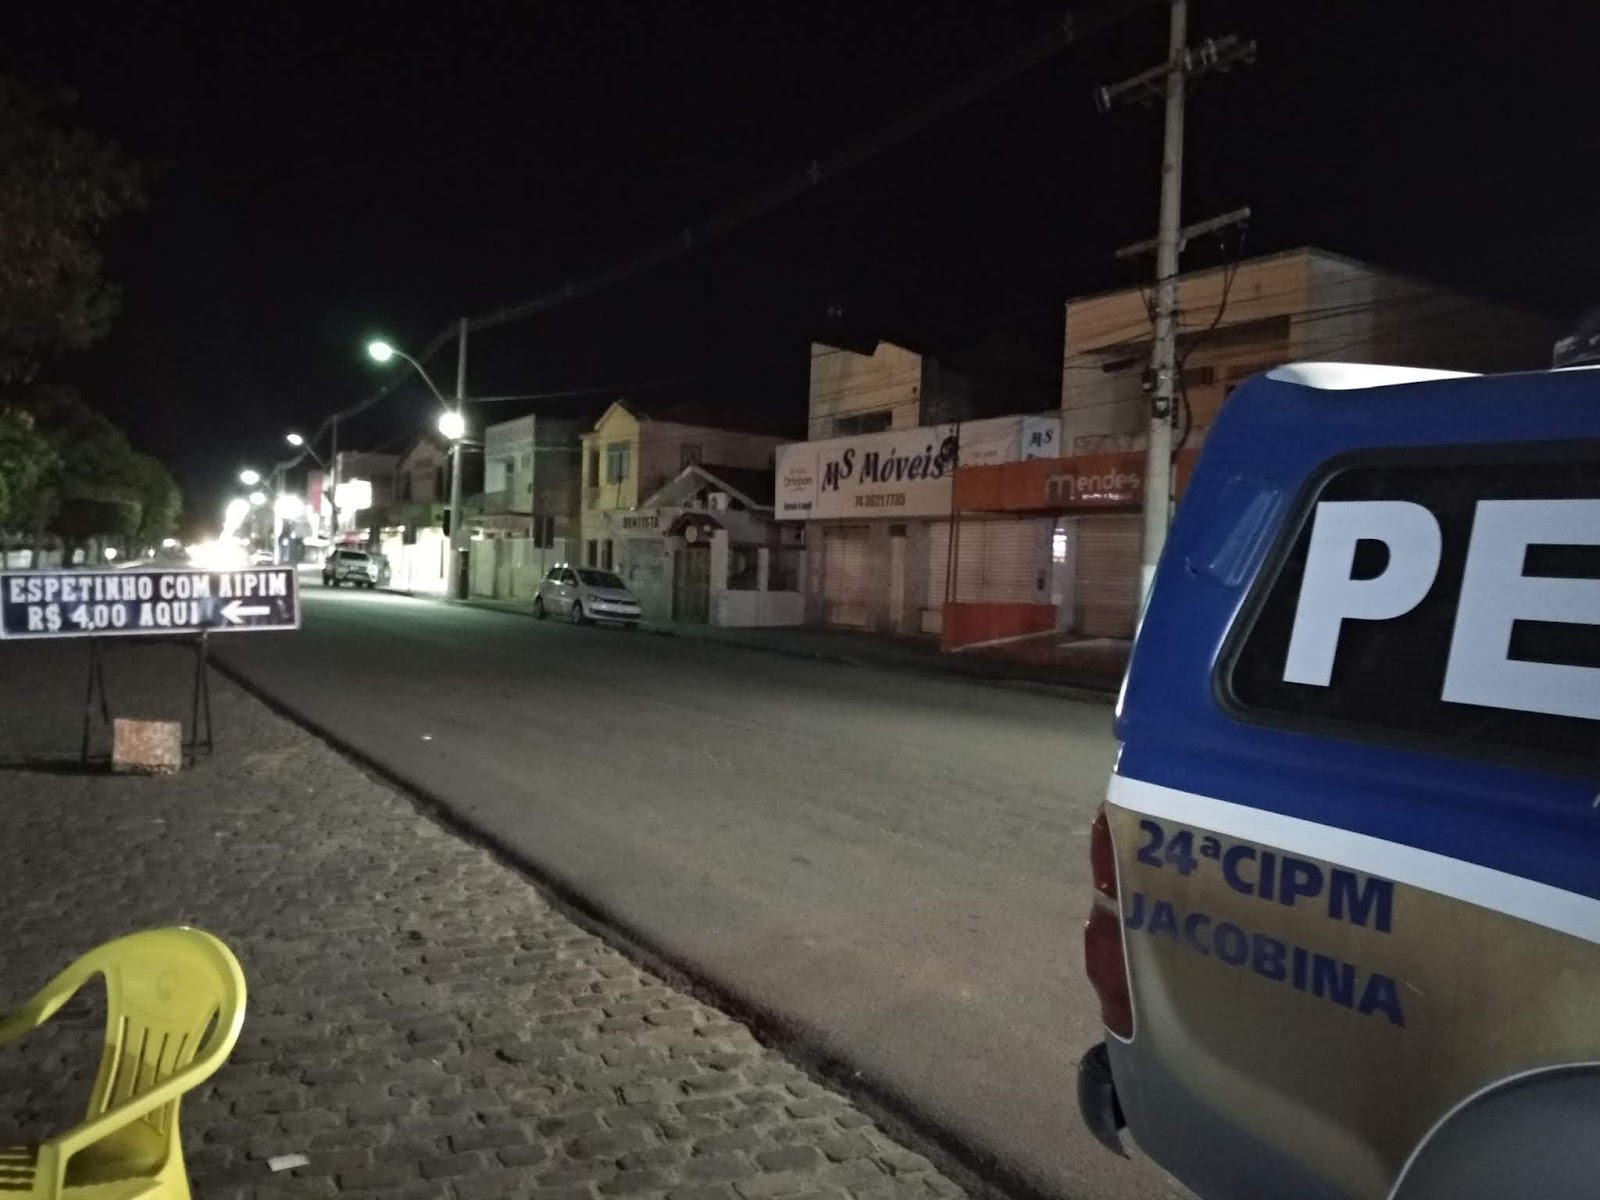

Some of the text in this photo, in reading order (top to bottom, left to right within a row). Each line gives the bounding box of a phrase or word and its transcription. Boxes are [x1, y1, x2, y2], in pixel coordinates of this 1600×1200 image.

[859, 444, 946, 485] Móveis
[10, 572, 287, 603] ESPETINHO COM AIPIM
[27, 601, 201, 632] R$ 4,00 AQUI
[1123, 891, 1405, 1028] JACOBINA
